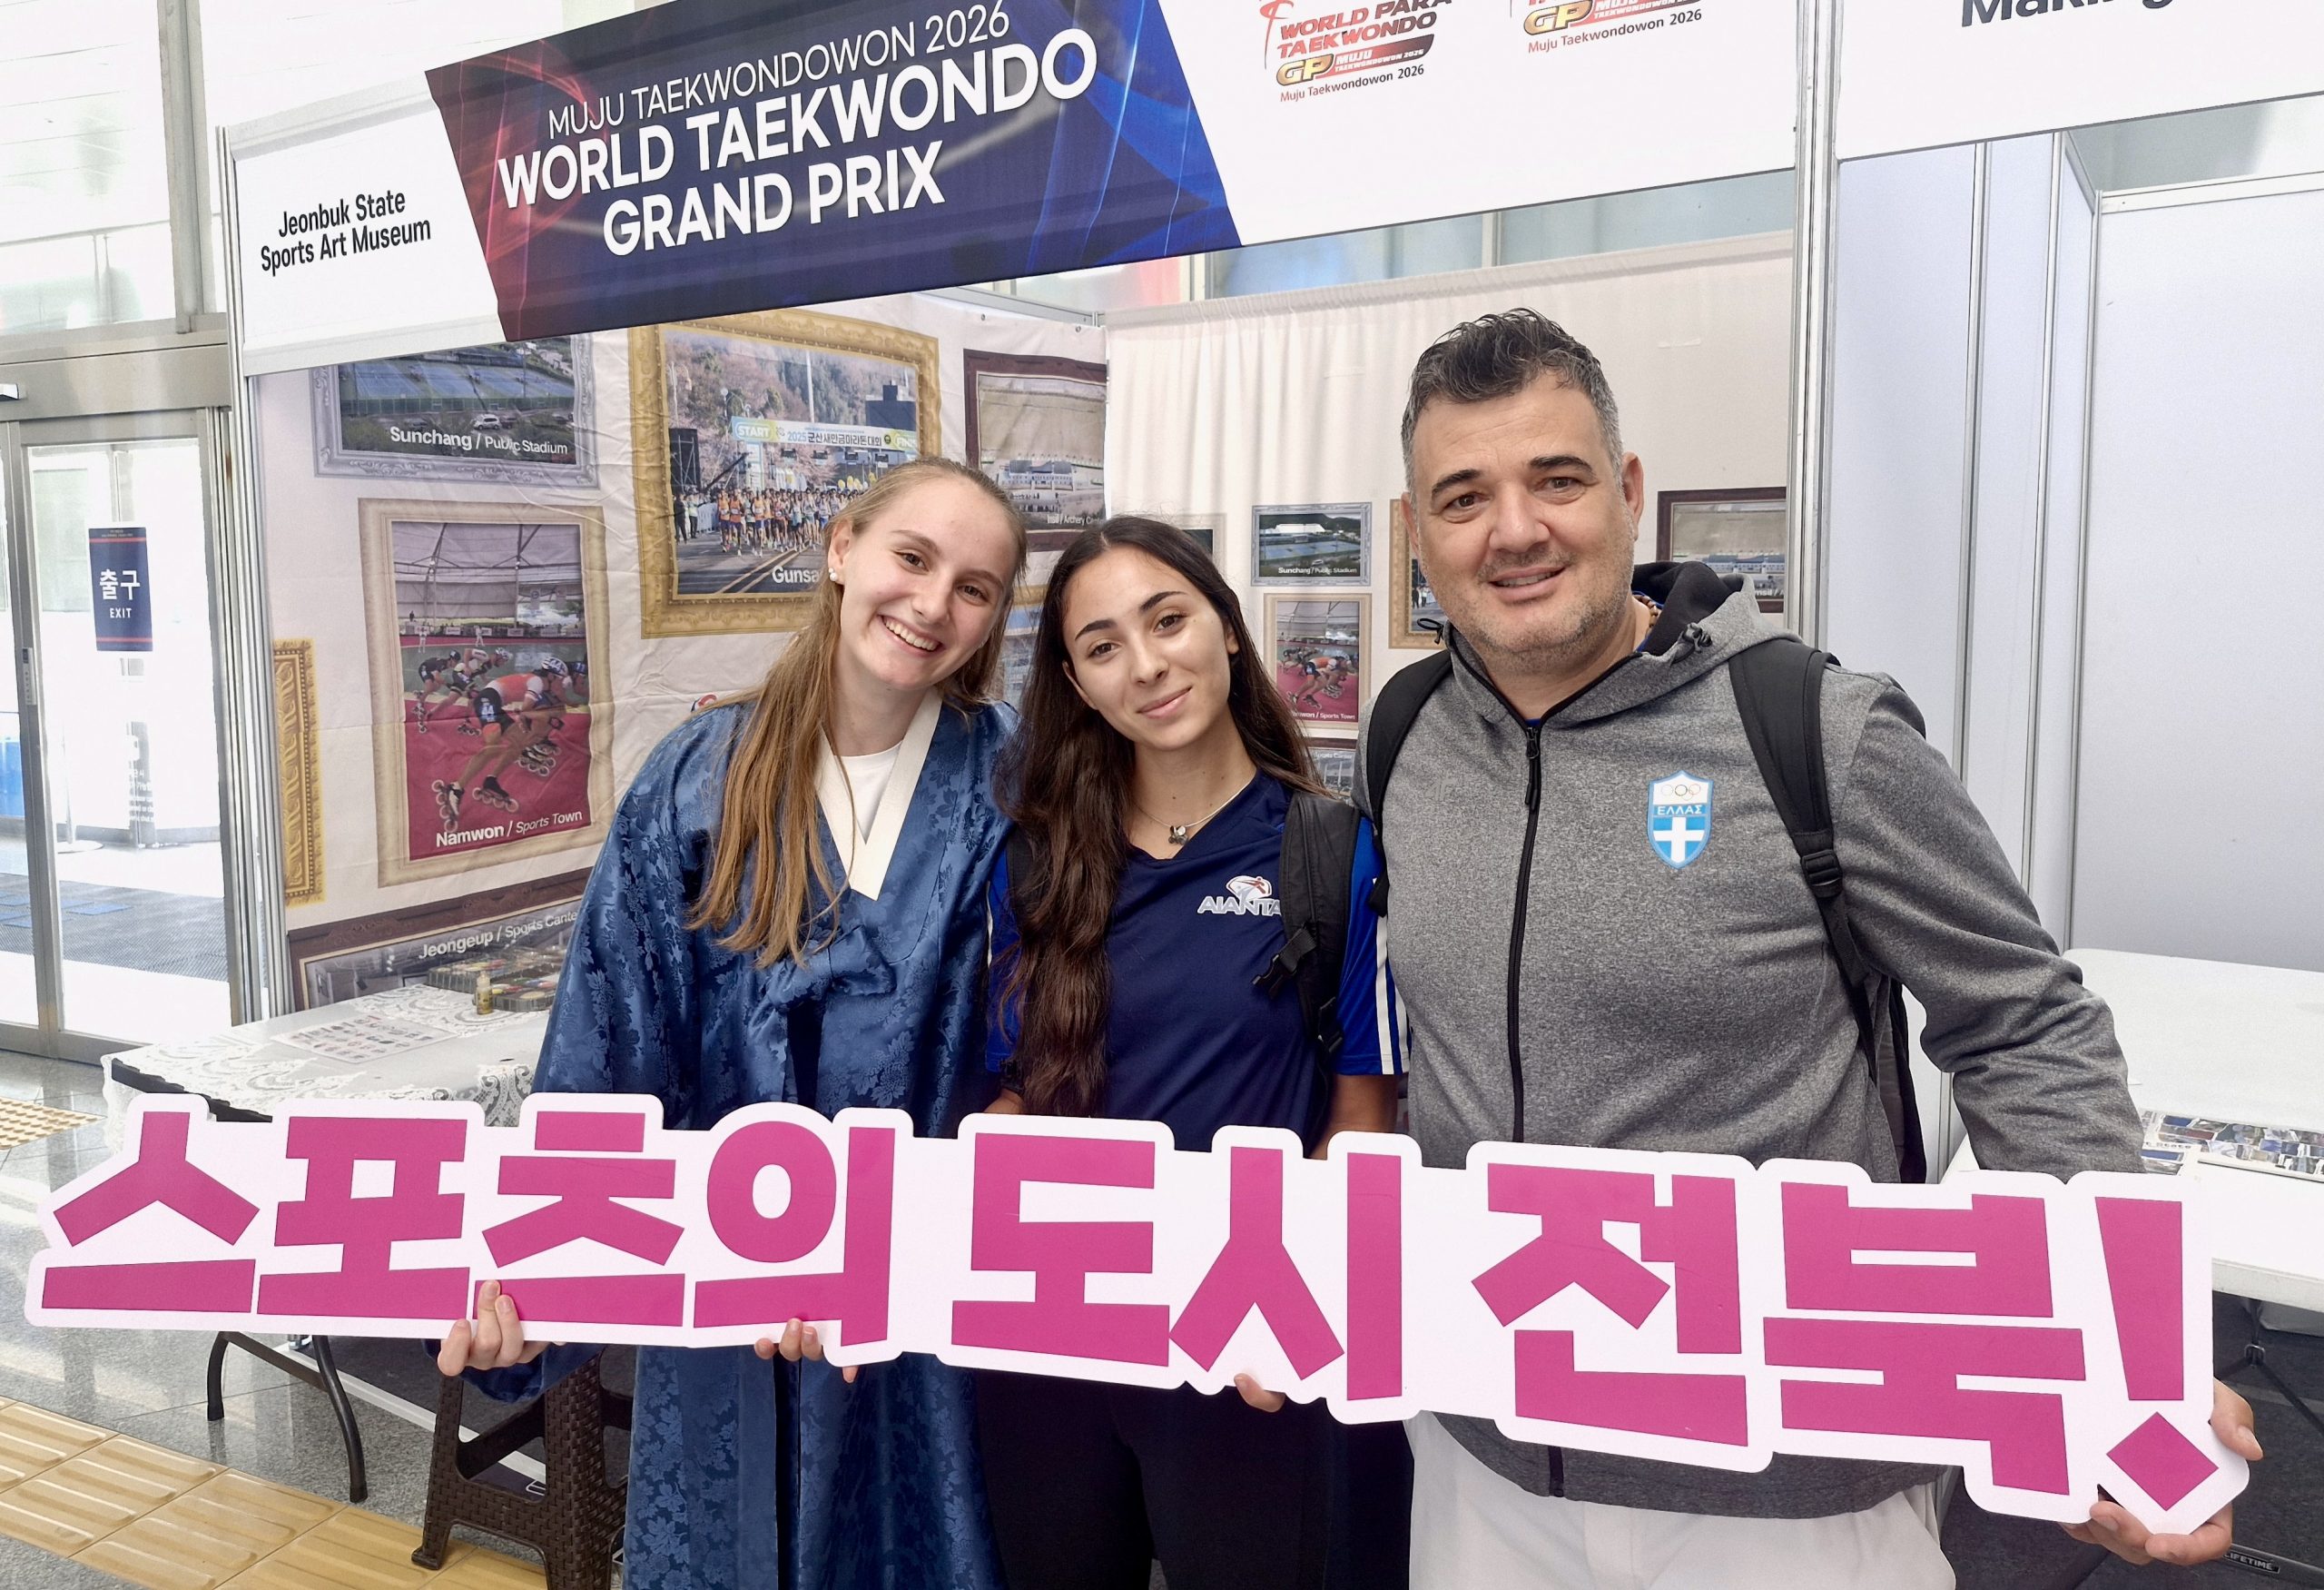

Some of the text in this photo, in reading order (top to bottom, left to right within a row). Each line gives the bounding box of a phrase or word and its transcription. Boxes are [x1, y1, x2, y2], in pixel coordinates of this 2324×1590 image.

[1281, 7, 1369, 40] WORLD
[1523, 0, 1593, 35] GP
[1528, 9, 1702, 54] Muju Taekwondowon 2026
[1277, 12, 1437, 59] TAEKWONDO
[548, 2, 1010, 140] MUJU TAEKWONDOWON 2026
[1276, 54, 1334, 85] GP
[1335, 50, 1374, 65] MUJU
[1280, 64, 1424, 102] Muju Taekwondowon 2026
[497, 28, 1098, 209] WORLD TAEKWONDO
[279, 190, 406, 237] Jeonbuk State
[604, 140, 946, 257] GRAND PRIX
[261, 220, 431, 277] Sports Art Museum
[390, 426, 472, 451] Sunchang
[485, 436, 520, 452] Public
[521, 439, 568, 455] Stadium
[737, 425, 770, 439] START
[787, 432, 807, 442] 2025
[99, 568, 141, 600] 출구
[773, 566, 821, 584] Gunsa
[1278, 567, 1310, 575] Sunchang
[109, 607, 133, 618] EXIT
[1657, 805, 1703, 815] ΕΛΛΑΣ
[436, 825, 505, 847] Namwon
[516, 816, 549, 835] Sports
[552, 811, 583, 825] Town
[419, 931, 494, 959] Jeongeup
[505, 919, 543, 939] Sports
[546, 911, 577, 927] Cante
[42, 1111, 2219, 1512] 스포츠의 도시 전북!
